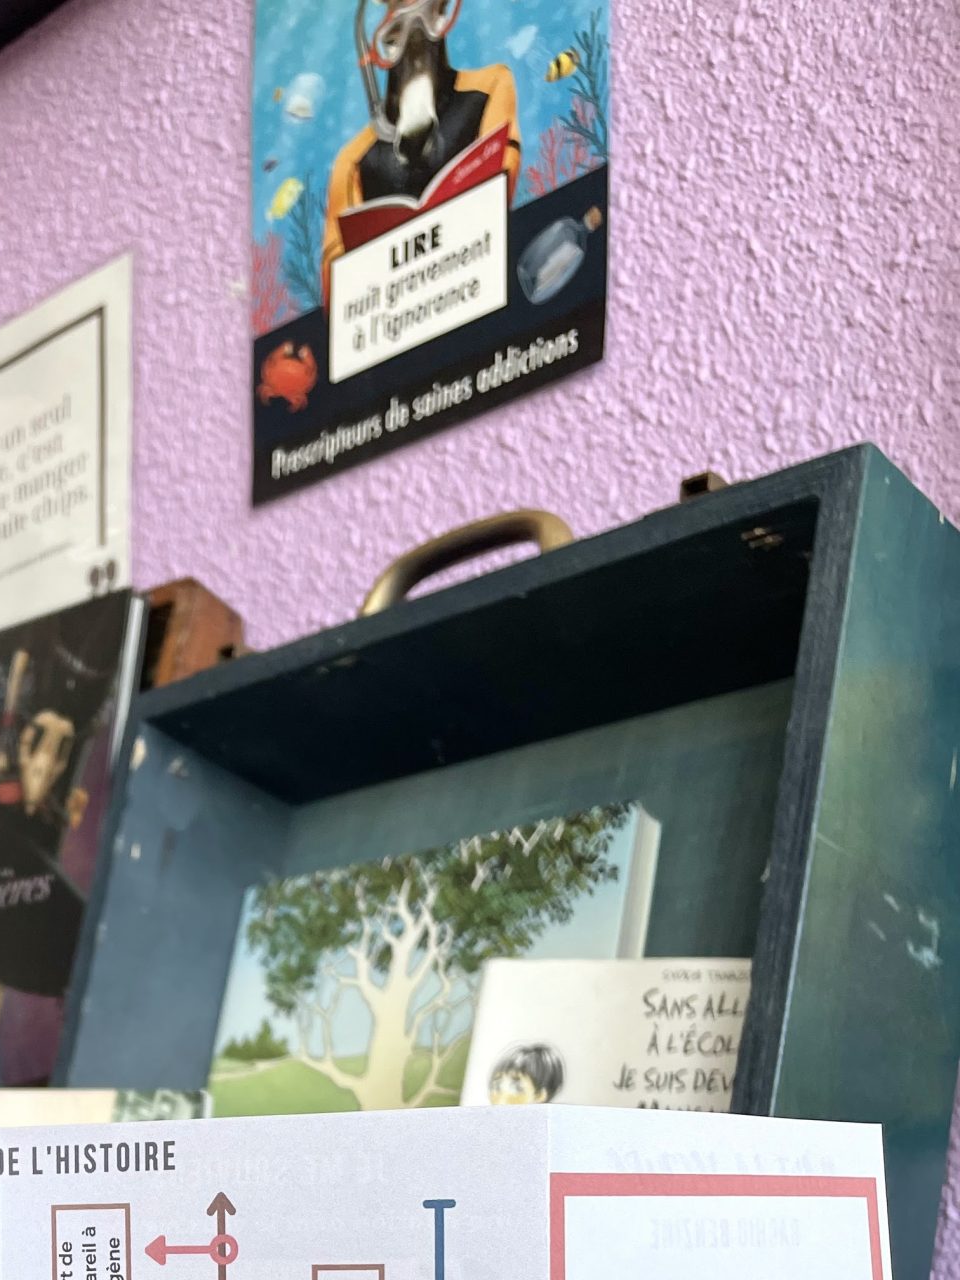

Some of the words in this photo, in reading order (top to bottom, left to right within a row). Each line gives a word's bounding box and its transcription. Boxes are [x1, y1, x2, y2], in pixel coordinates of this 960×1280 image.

[391, 224, 443, 269] LIRE
[344, 284, 381, 324] nuit
[385, 232, 491, 304] gravement
[352, 326, 366, 352] à
[271, 413, 382, 480] Prescripteurs
[385, 396, 410, 433] de
[412, 375, 473, 421] saines
[476, 329, 579, 394] addictions
[642, 986, 698, 1020] SANS
[612, 1062, 636, 1093] JE
[643, 1066, 686, 1094] SUIS
[32, 1140, 177, 1175] L'HISTOIRE
[82, 1225, 97, 1237] à
[59, 1241, 74, 1266] de
